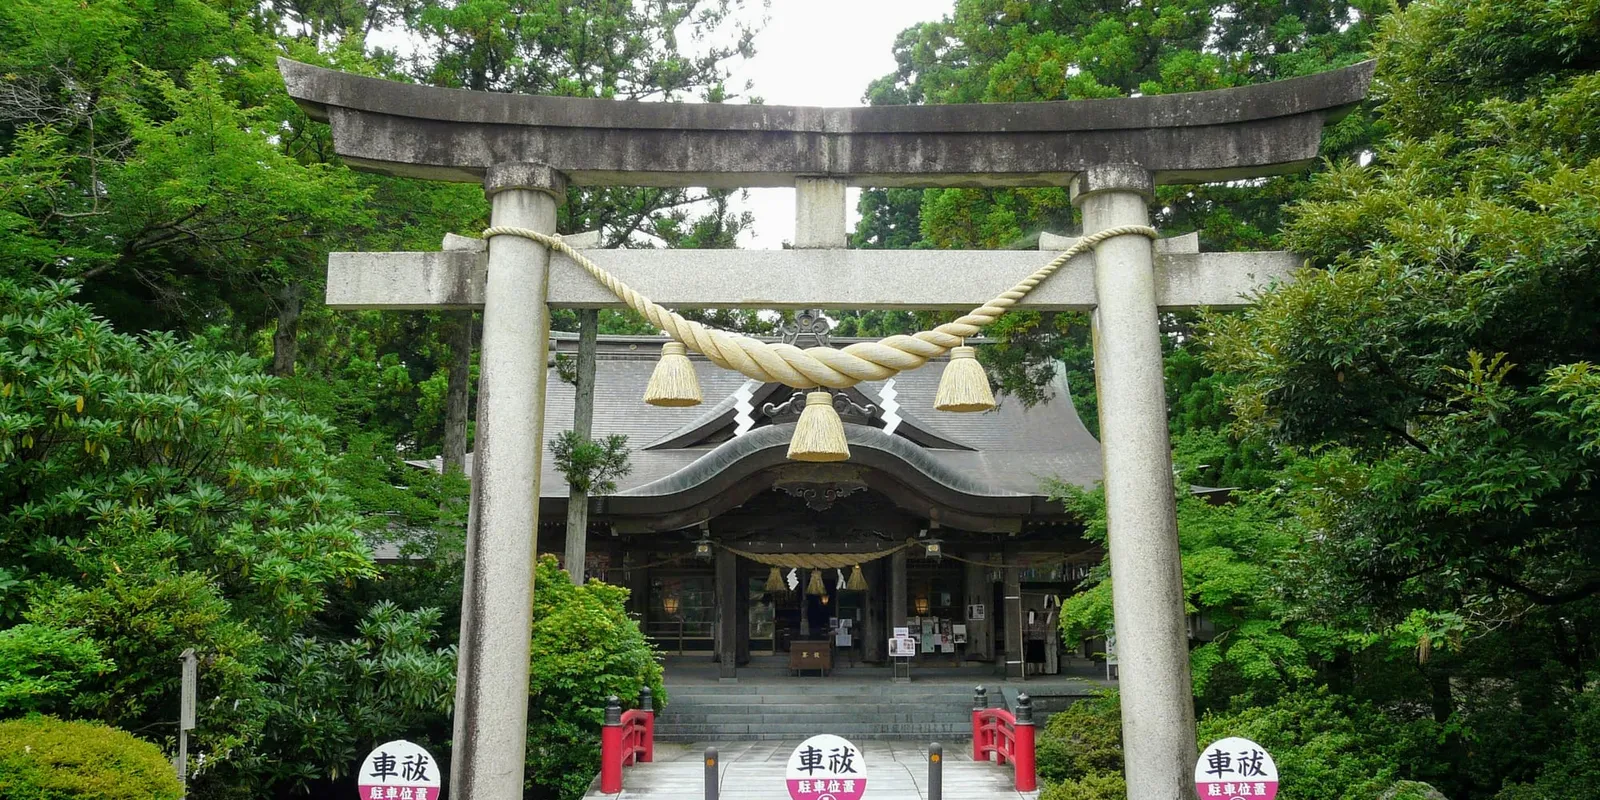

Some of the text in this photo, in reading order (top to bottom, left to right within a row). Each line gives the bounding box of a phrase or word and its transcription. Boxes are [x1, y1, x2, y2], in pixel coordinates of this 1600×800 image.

[369, 751, 430, 783] 車祓
[796, 745, 857, 776] 車祓
[1205, 748, 1267, 779] 車祓
[370, 786, 428, 800] 駐車位置
[798, 780, 855, 794] 駐車位置
[1208, 782, 1266, 796] 駐車位置
